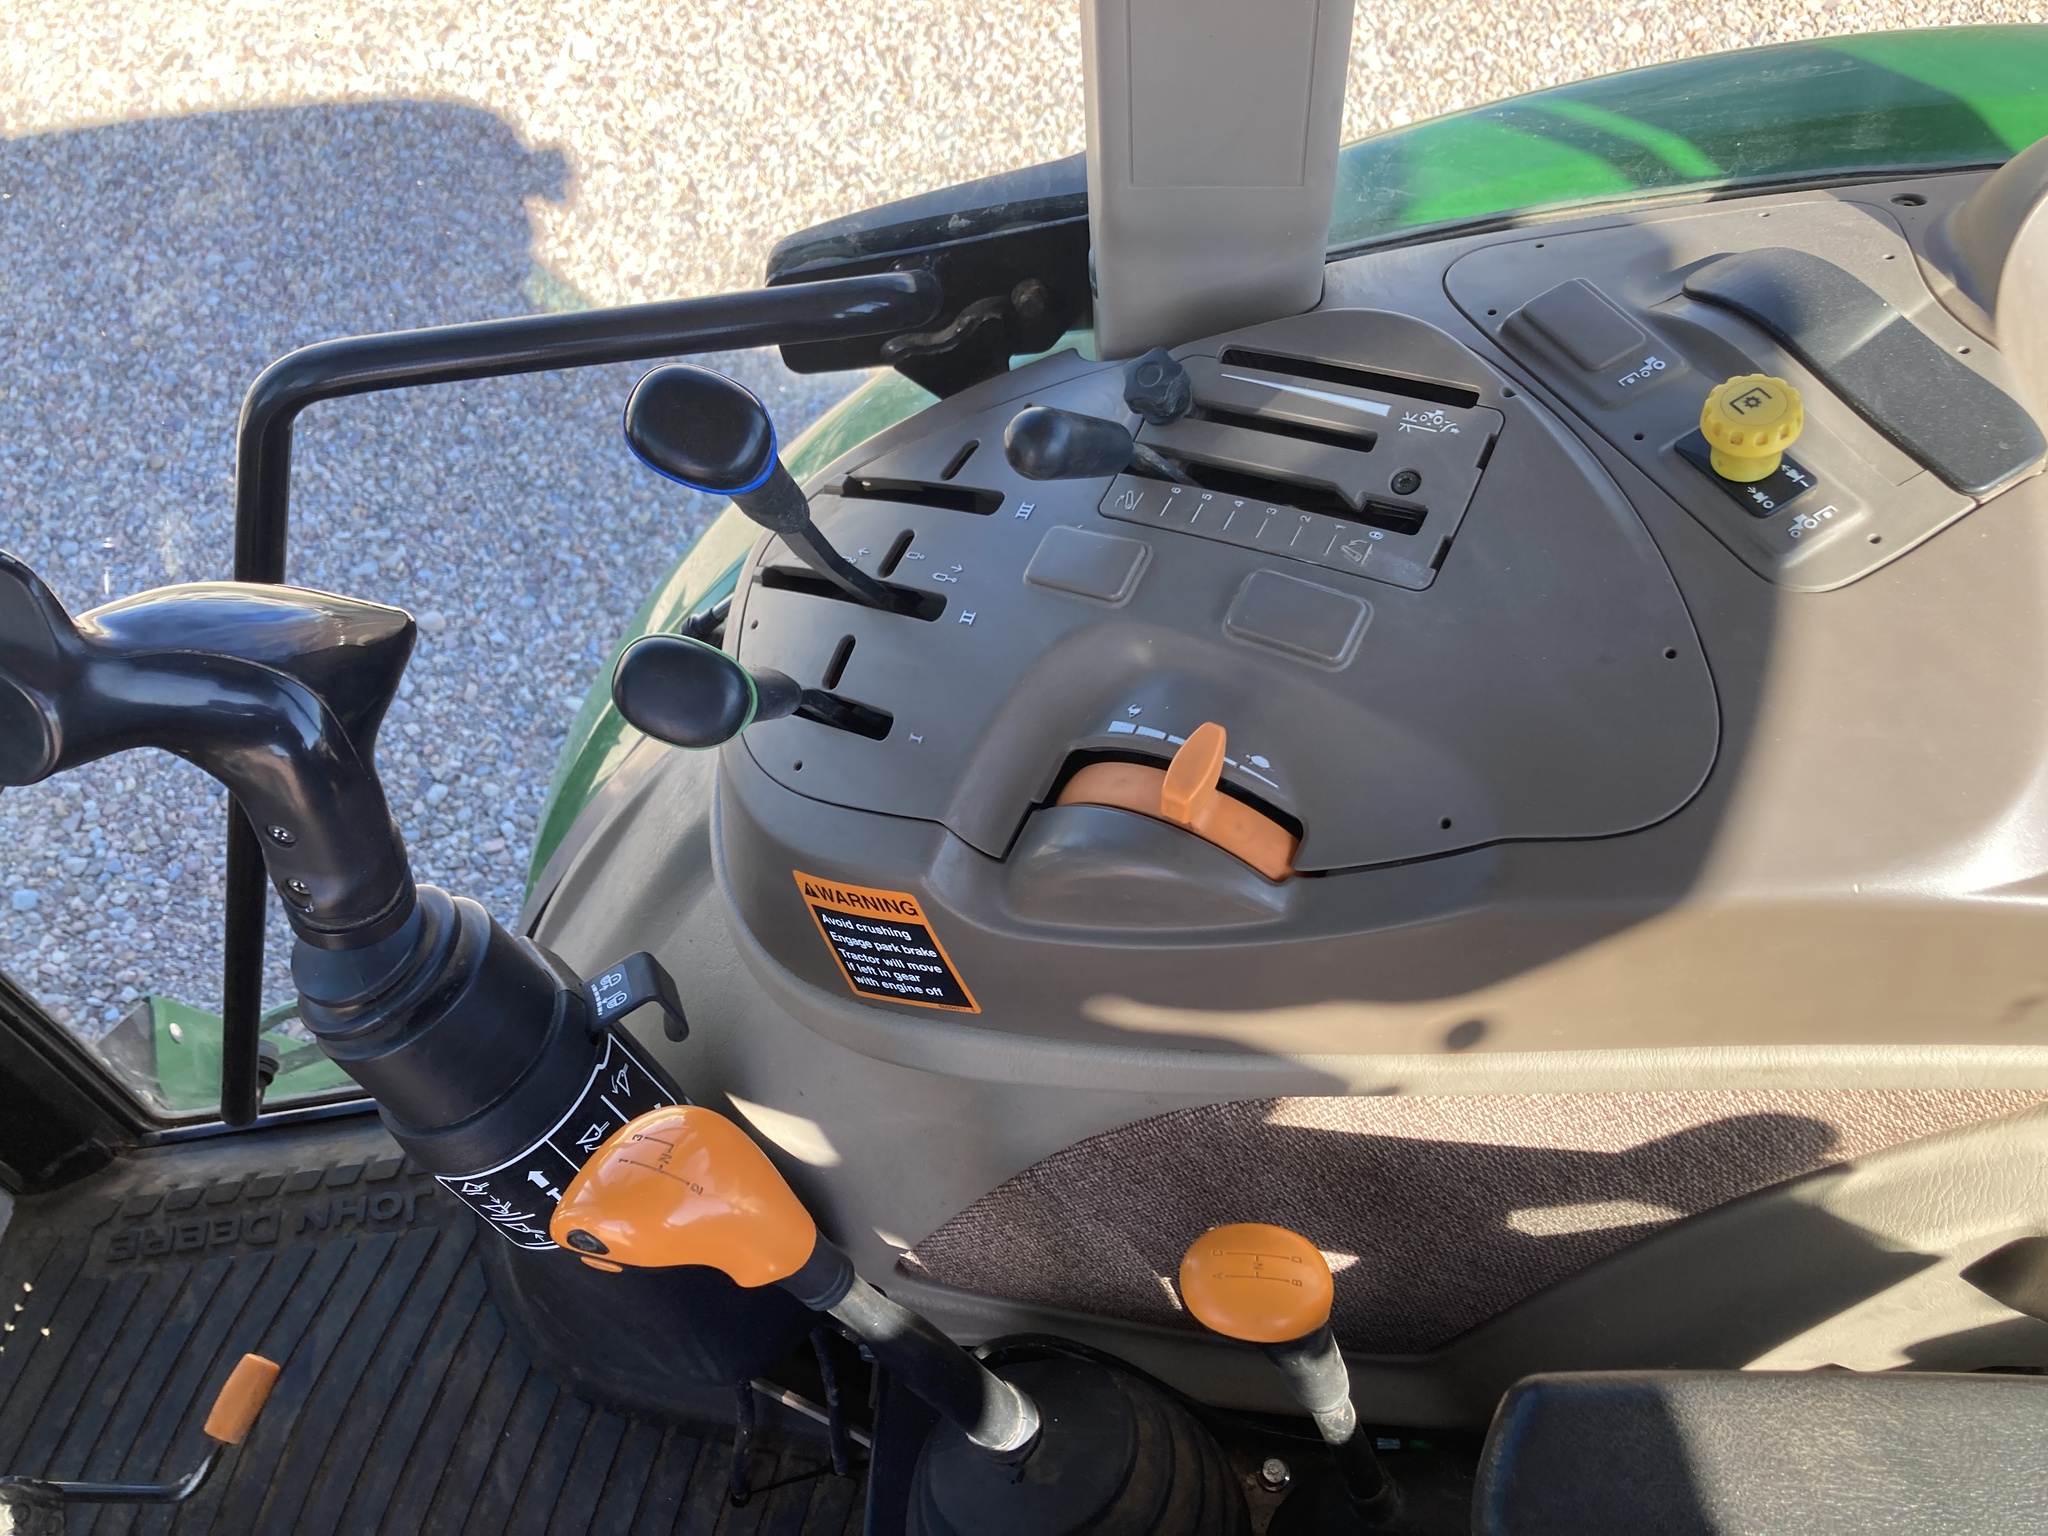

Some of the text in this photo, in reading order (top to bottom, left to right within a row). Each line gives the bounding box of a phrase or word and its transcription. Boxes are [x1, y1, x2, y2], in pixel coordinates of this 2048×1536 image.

[1171, 486, 1181, 494] 6
[1201, 493, 1213, 501] 5
[1234, 500, 1245, 508] 4
[1266, 507, 1278, 515] 3
[1300, 515, 1312, 523] 2
[815, 884, 919, 917] WARNING
[821, 913, 912, 942] Avoid crushing
[829, 931, 938, 958] Engage park brake
[838, 947, 943, 974] Tractor will move
[846, 961, 921, 983] if left in gear
[854, 976, 944, 997] with engine off
[631, 1133, 644, 1142] 3
[690, 1182, 704, 1195] 2
[106, 1187, 436, 1263] JOHN DEERE
[1212, 1249, 1223, 1257] C
[1291, 1256, 1303, 1264] D
[1212, 1272, 1223, 1280] A
[1291, 1278, 1303, 1287] B
